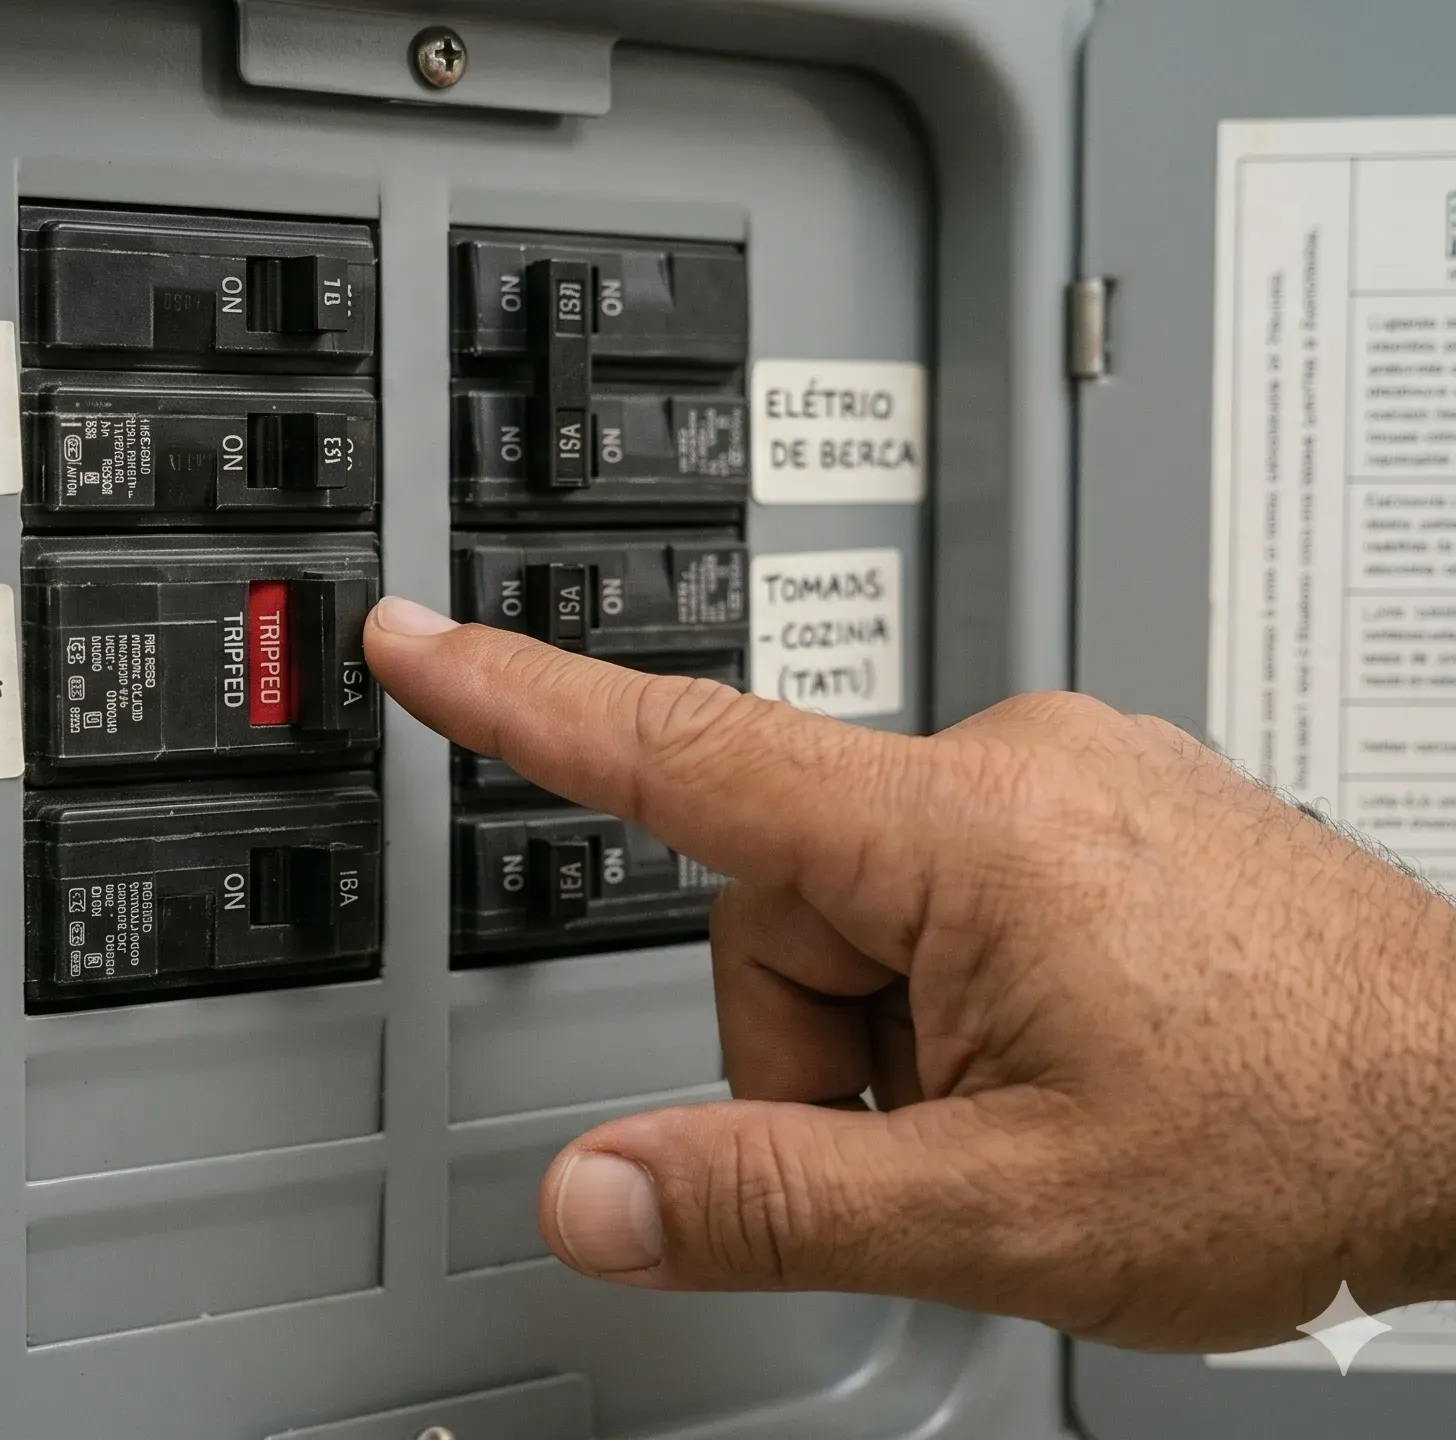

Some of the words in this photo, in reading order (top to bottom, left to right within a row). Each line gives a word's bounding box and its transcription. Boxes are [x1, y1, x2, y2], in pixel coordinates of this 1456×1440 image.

[221, 276, 243, 313] ON
[500, 275, 522, 313] ON
[601, 278, 624, 317] ON
[222, 434, 244, 471] ON
[501, 425, 522, 462] ON
[602, 427, 623, 464] ON
[771, 439, 806, 469] DE
[502, 580, 522, 617] ON
[602, 578, 624, 616] ON
[503, 854, 524, 892] ON
[603, 847, 626, 885] ON
[223, 873, 246, 911] ON
